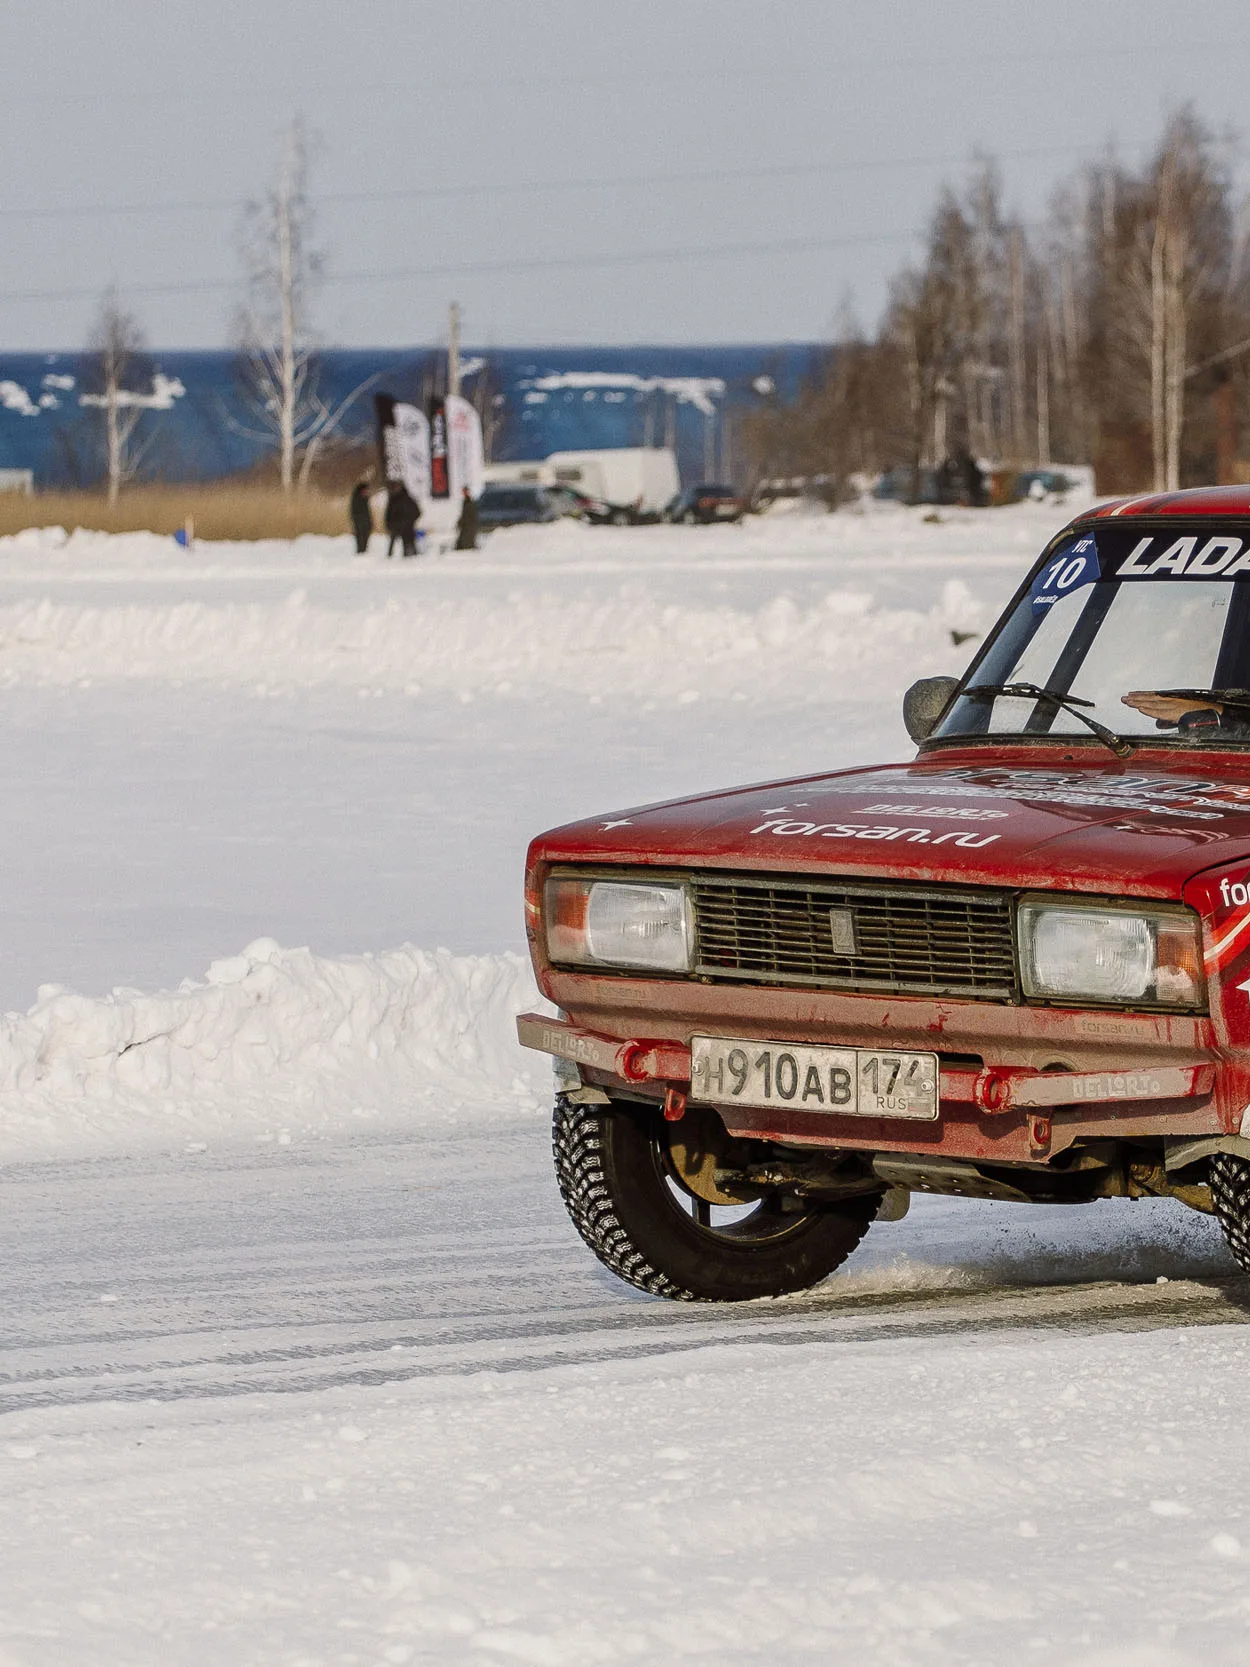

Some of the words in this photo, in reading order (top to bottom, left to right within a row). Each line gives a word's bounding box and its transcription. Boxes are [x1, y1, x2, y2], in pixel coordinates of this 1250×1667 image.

[1042, 557, 1087, 590] 10
[749, 818, 1003, 849] forsan.ru
[876, 1096, 907, 1110] RUS
